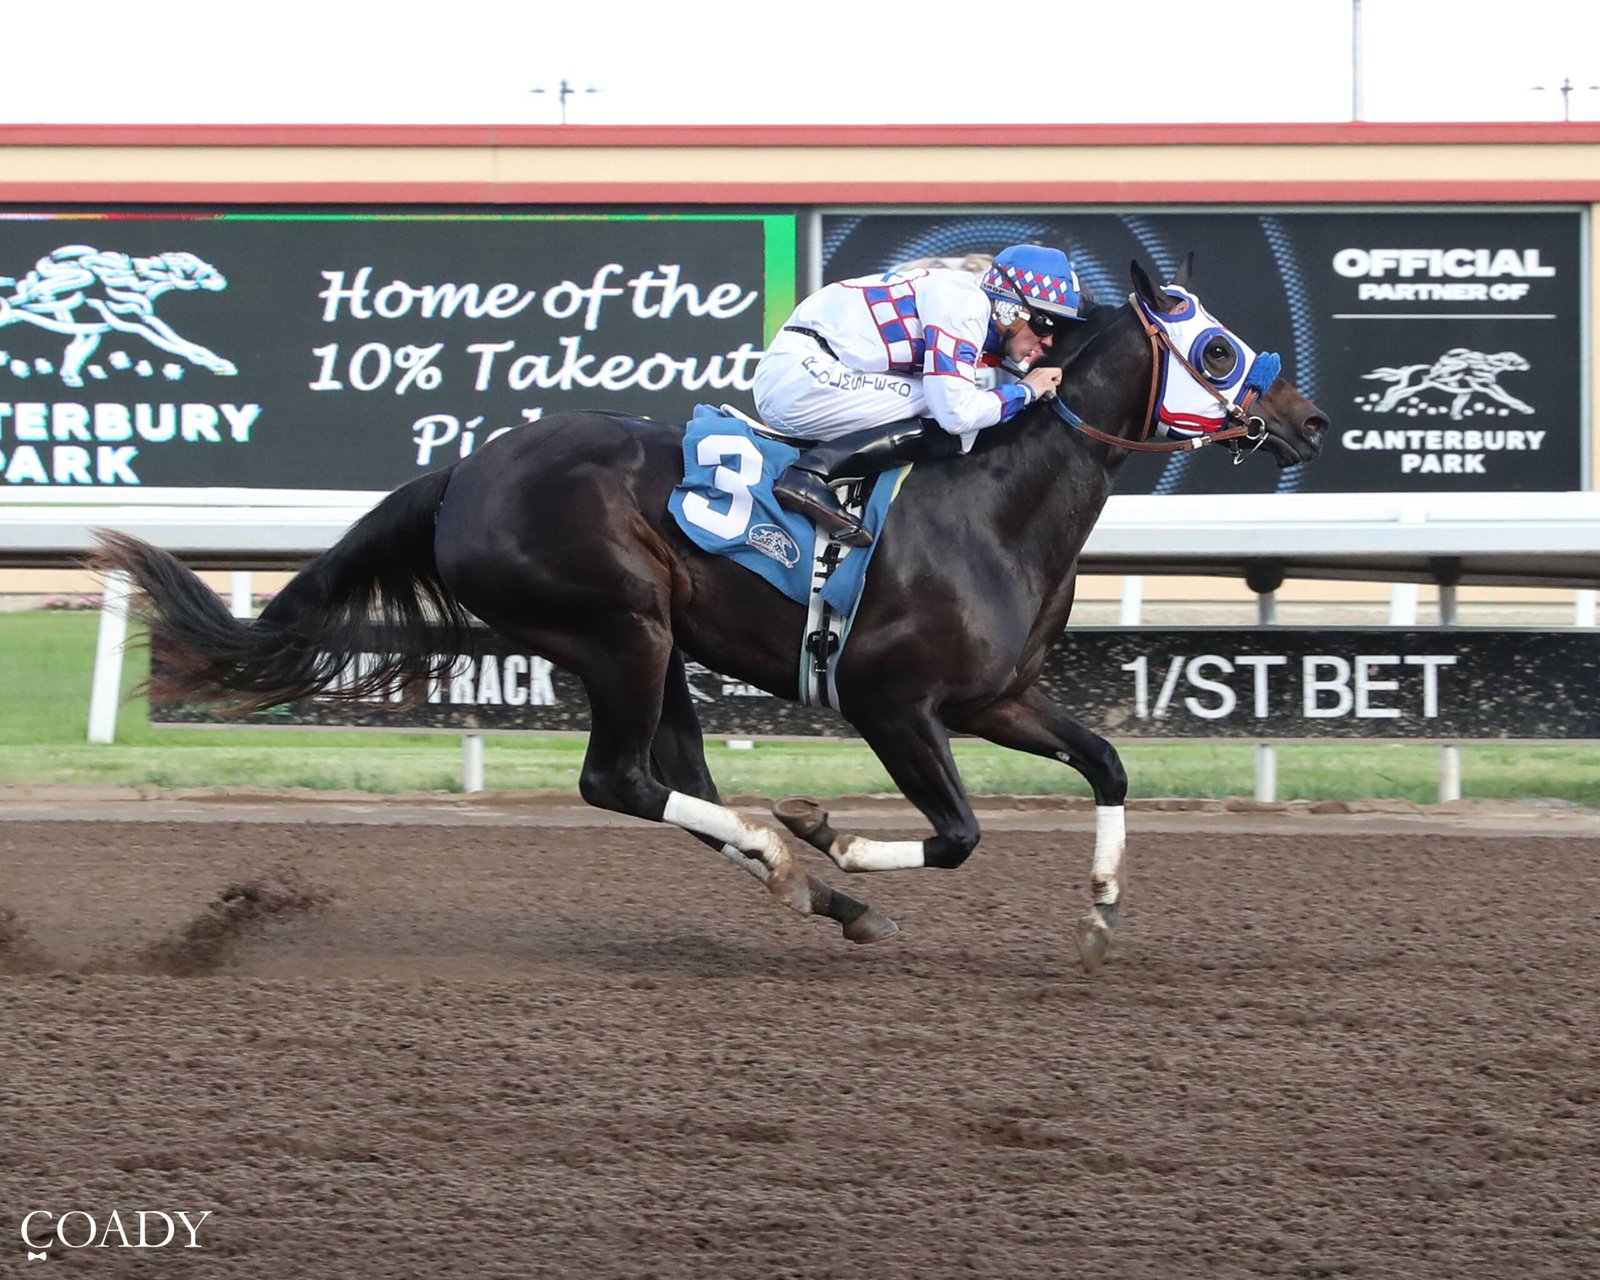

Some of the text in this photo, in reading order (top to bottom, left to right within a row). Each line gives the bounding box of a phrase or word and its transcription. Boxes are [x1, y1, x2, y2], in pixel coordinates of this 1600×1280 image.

[1332, 248, 1556, 278] OFFICIAL
[319, 263, 758, 331] Home of the
[1358, 283, 1530, 301] PARTNER OF
[308, 335, 765, 395] 10% Takeout
[1341, 430, 1547, 450] CANTERBURY
[0, 445, 141, 484] ARK
[1401, 453, 1486, 474] PARK
[681, 434, 763, 540] 3
[1120, 654, 1457, 719] 1/ST BET
